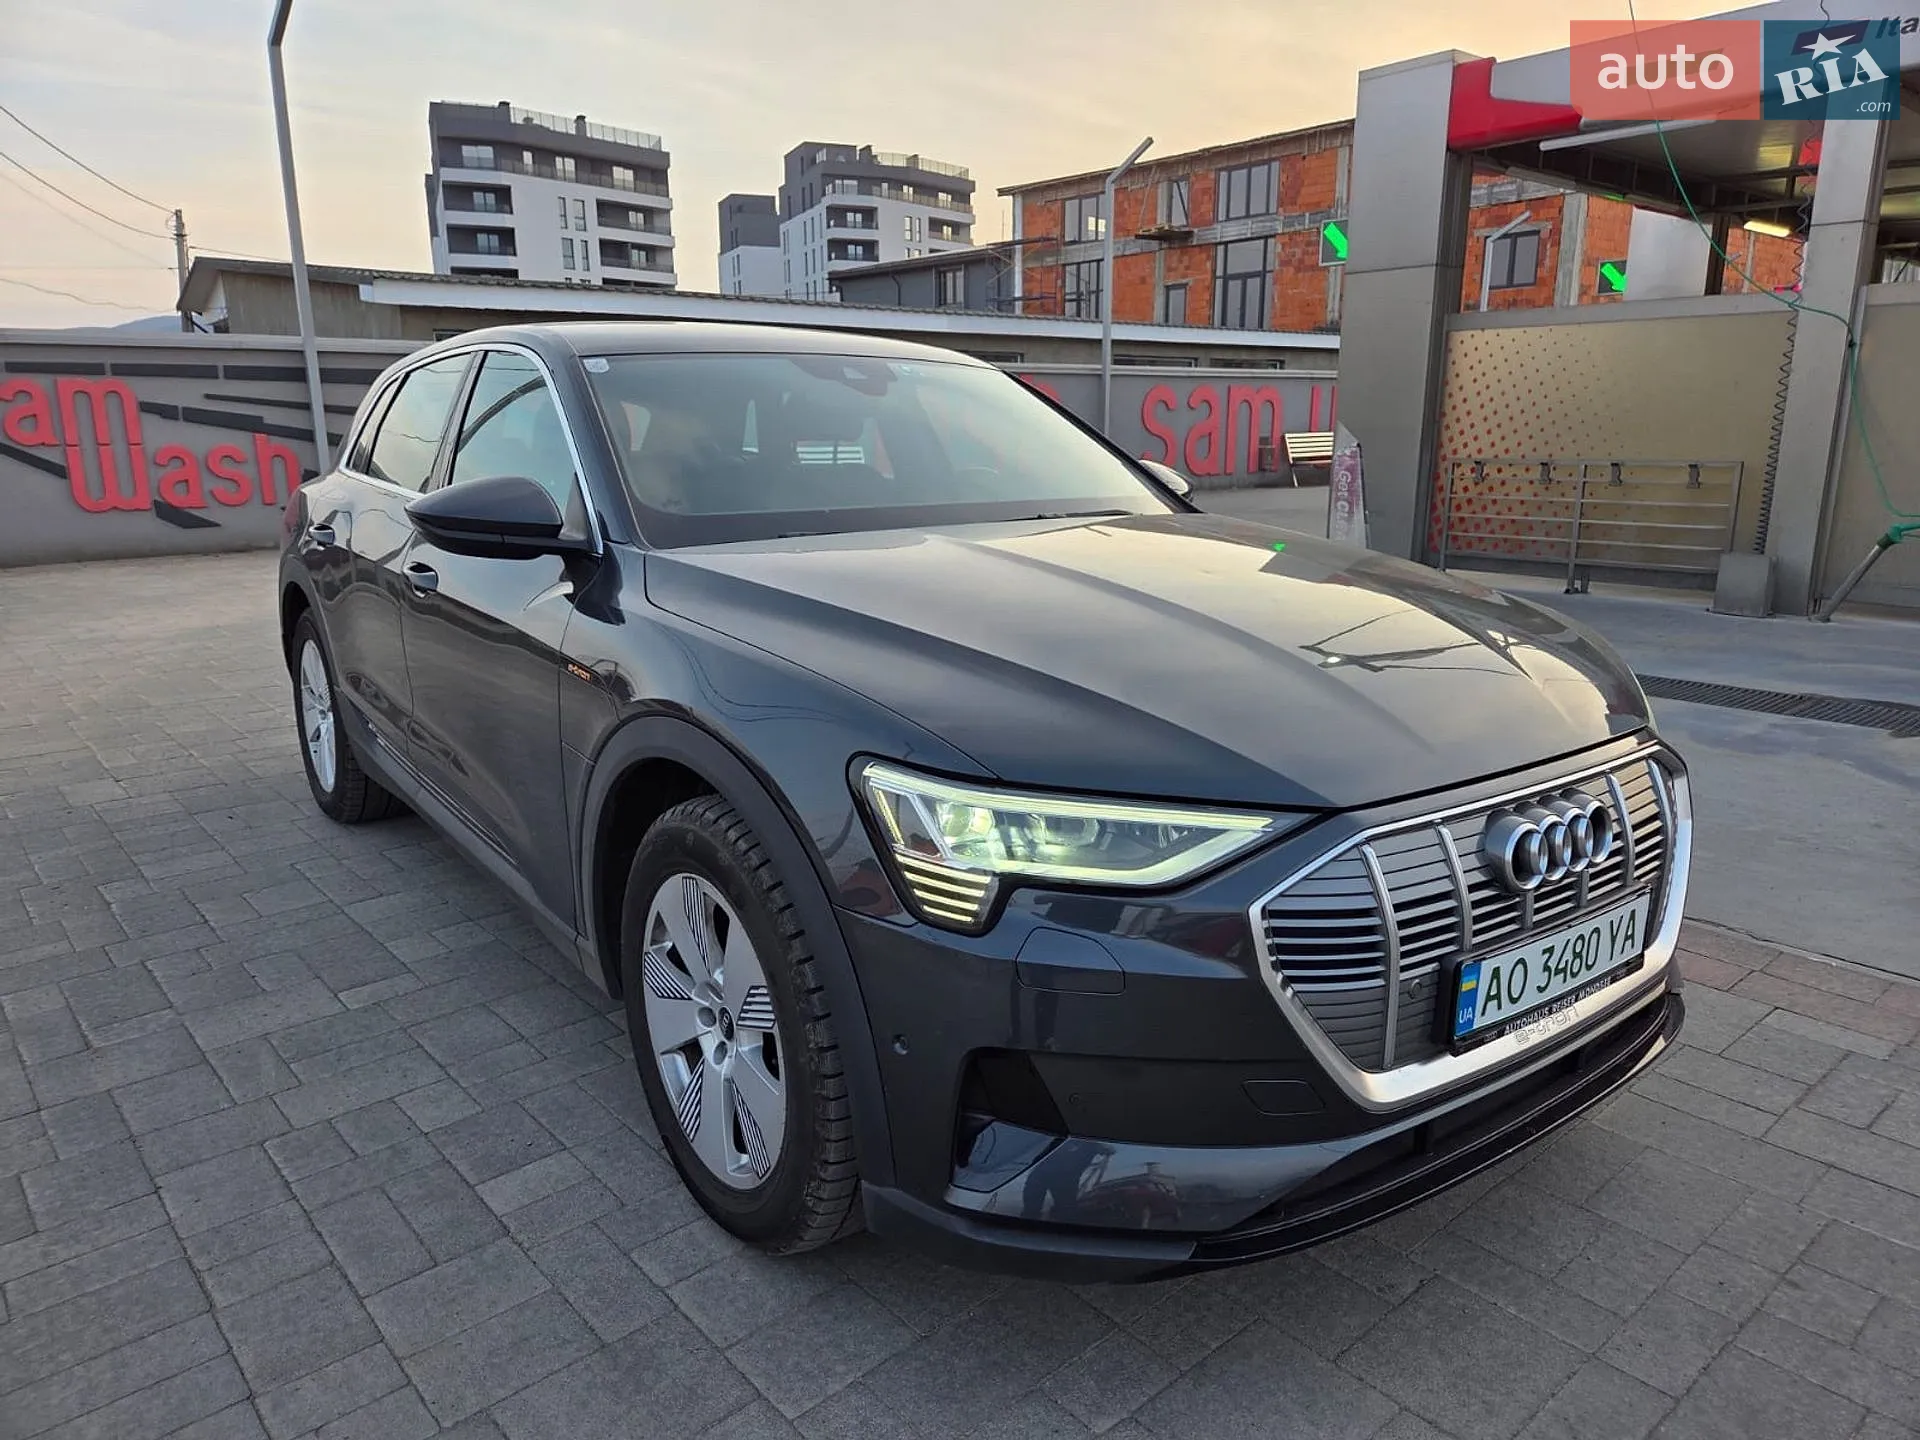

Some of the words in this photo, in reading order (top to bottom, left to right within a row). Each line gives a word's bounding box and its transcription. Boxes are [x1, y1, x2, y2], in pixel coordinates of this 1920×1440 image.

[1480, 957, 1528, 1017] AO
[1536, 926, 1601, 994] 3480
[1609, 908, 1637, 961] YA
[1459, 1007, 1474, 1024] UA
[1503, 1007, 1550, 1036] AUTOHAUS
